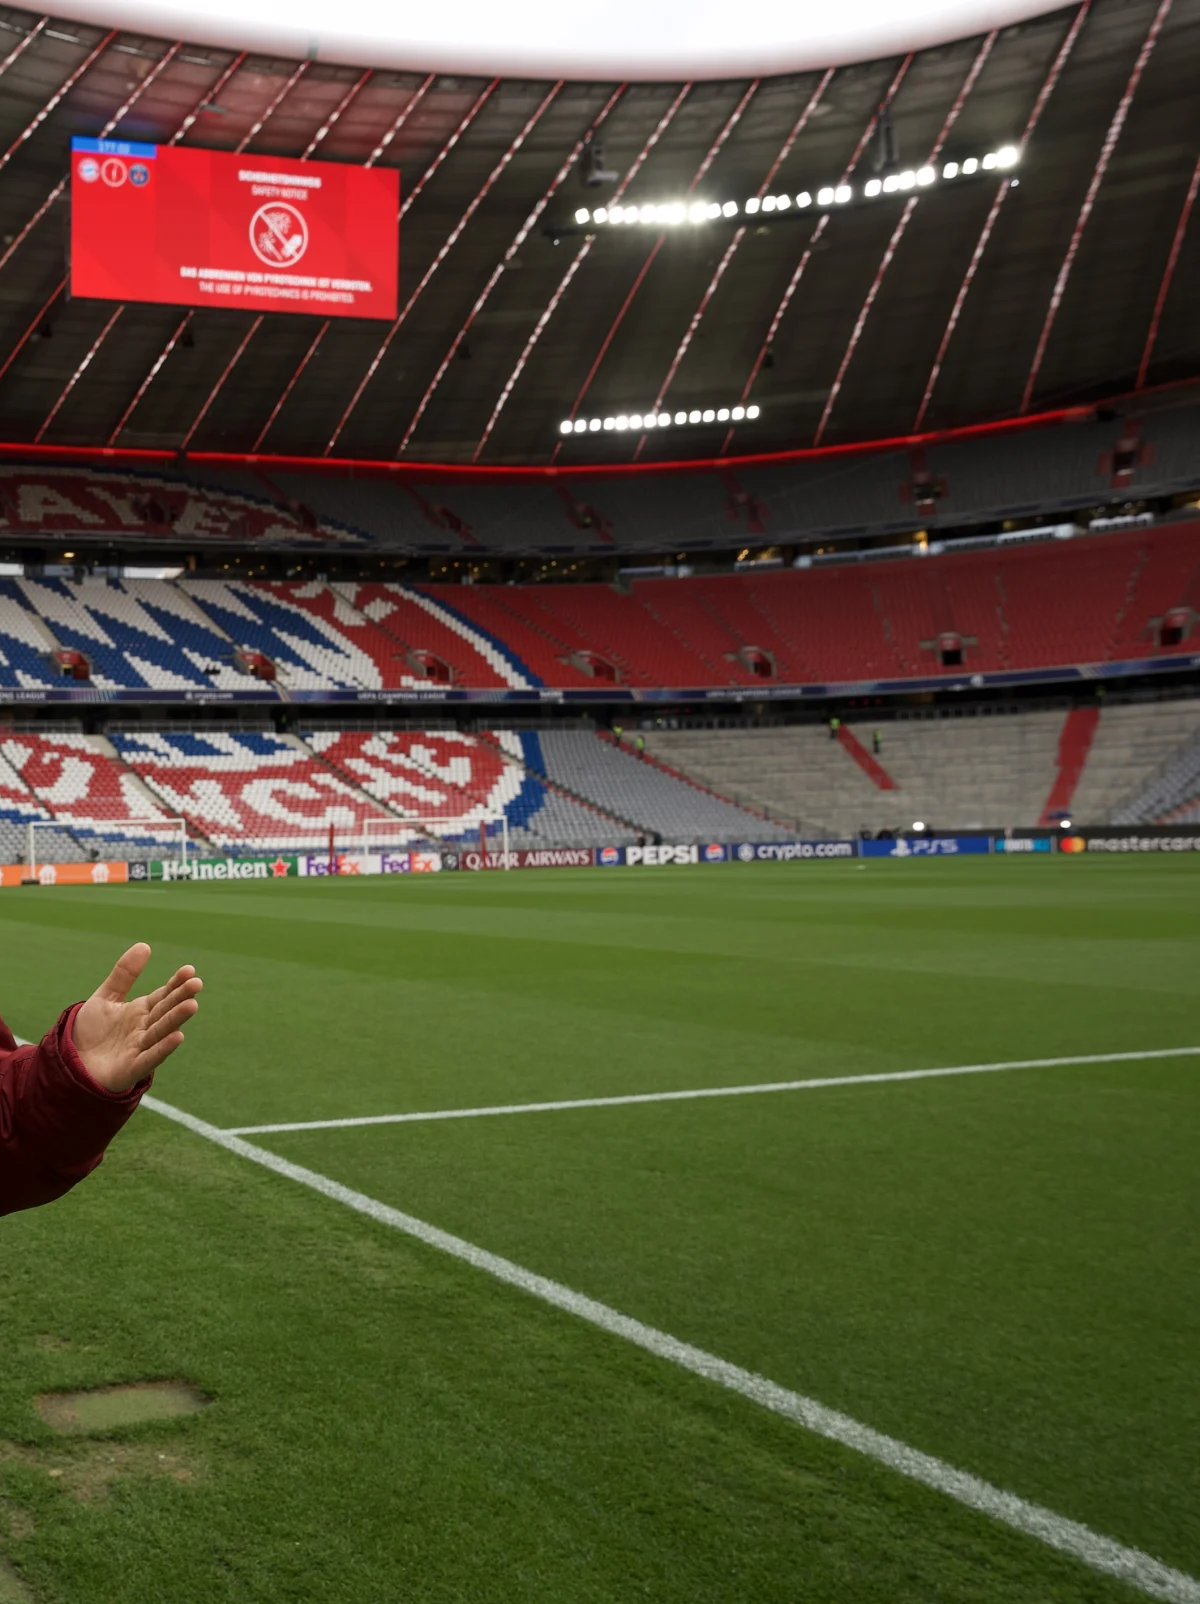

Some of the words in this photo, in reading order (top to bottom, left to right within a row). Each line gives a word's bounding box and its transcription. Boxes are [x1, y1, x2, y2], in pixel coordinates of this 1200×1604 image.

[625, 845, 698, 866] PEPSI
[757, 842, 852, 861] crypto.com
[912, 838, 958, 854] PS5
[161, 858, 269, 881] Heineken
[305, 855, 360, 876] FedEx
[381, 852, 434, 873] FedEx
[465, 852, 519, 871] QATAR
[524, 848, 590, 867] AIRWAYS
